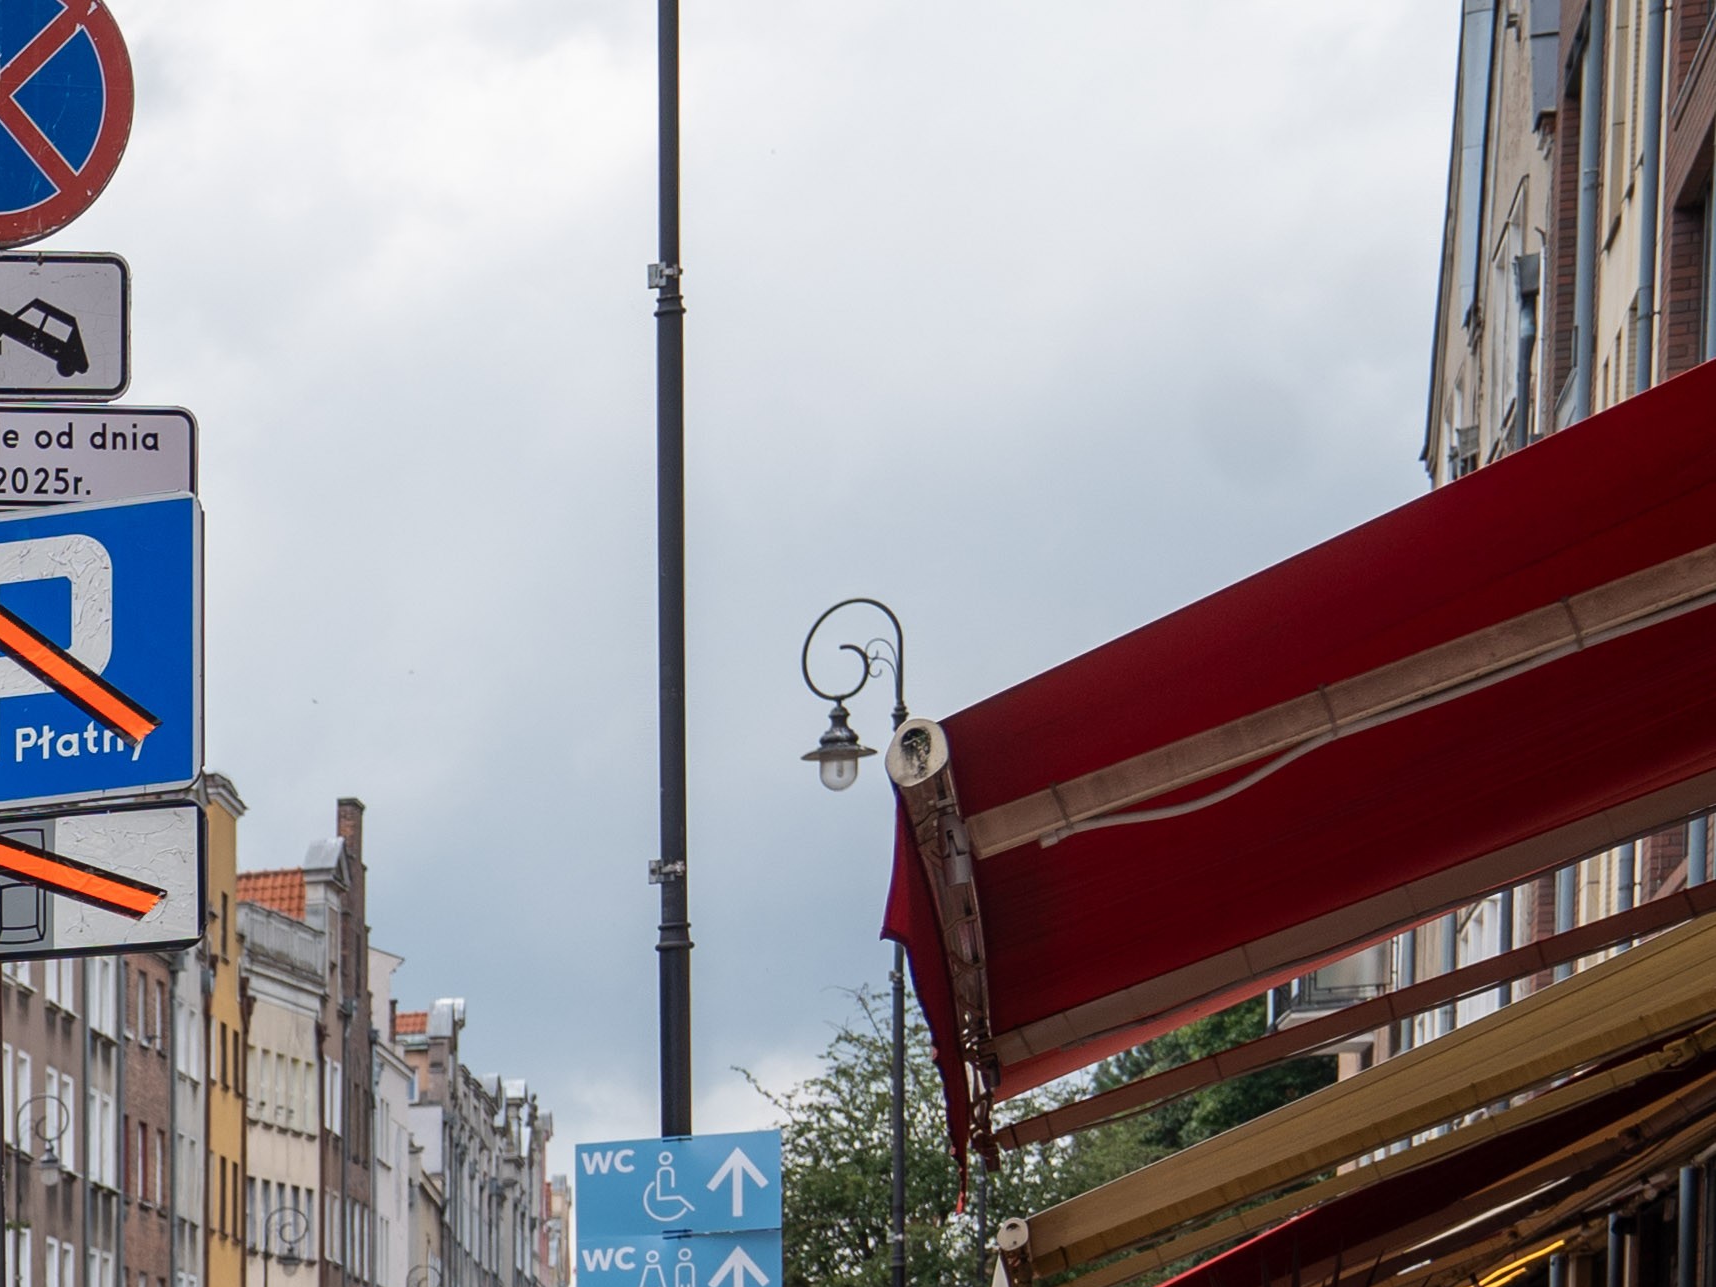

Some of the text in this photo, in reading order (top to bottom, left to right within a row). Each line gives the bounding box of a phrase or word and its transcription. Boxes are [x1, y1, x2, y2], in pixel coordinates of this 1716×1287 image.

[35, 423, 74, 451] od
[89, 423, 161, 452] dnia
[581, 1149, 636, 1175] WC
[581, 1246, 637, 1272] WC
